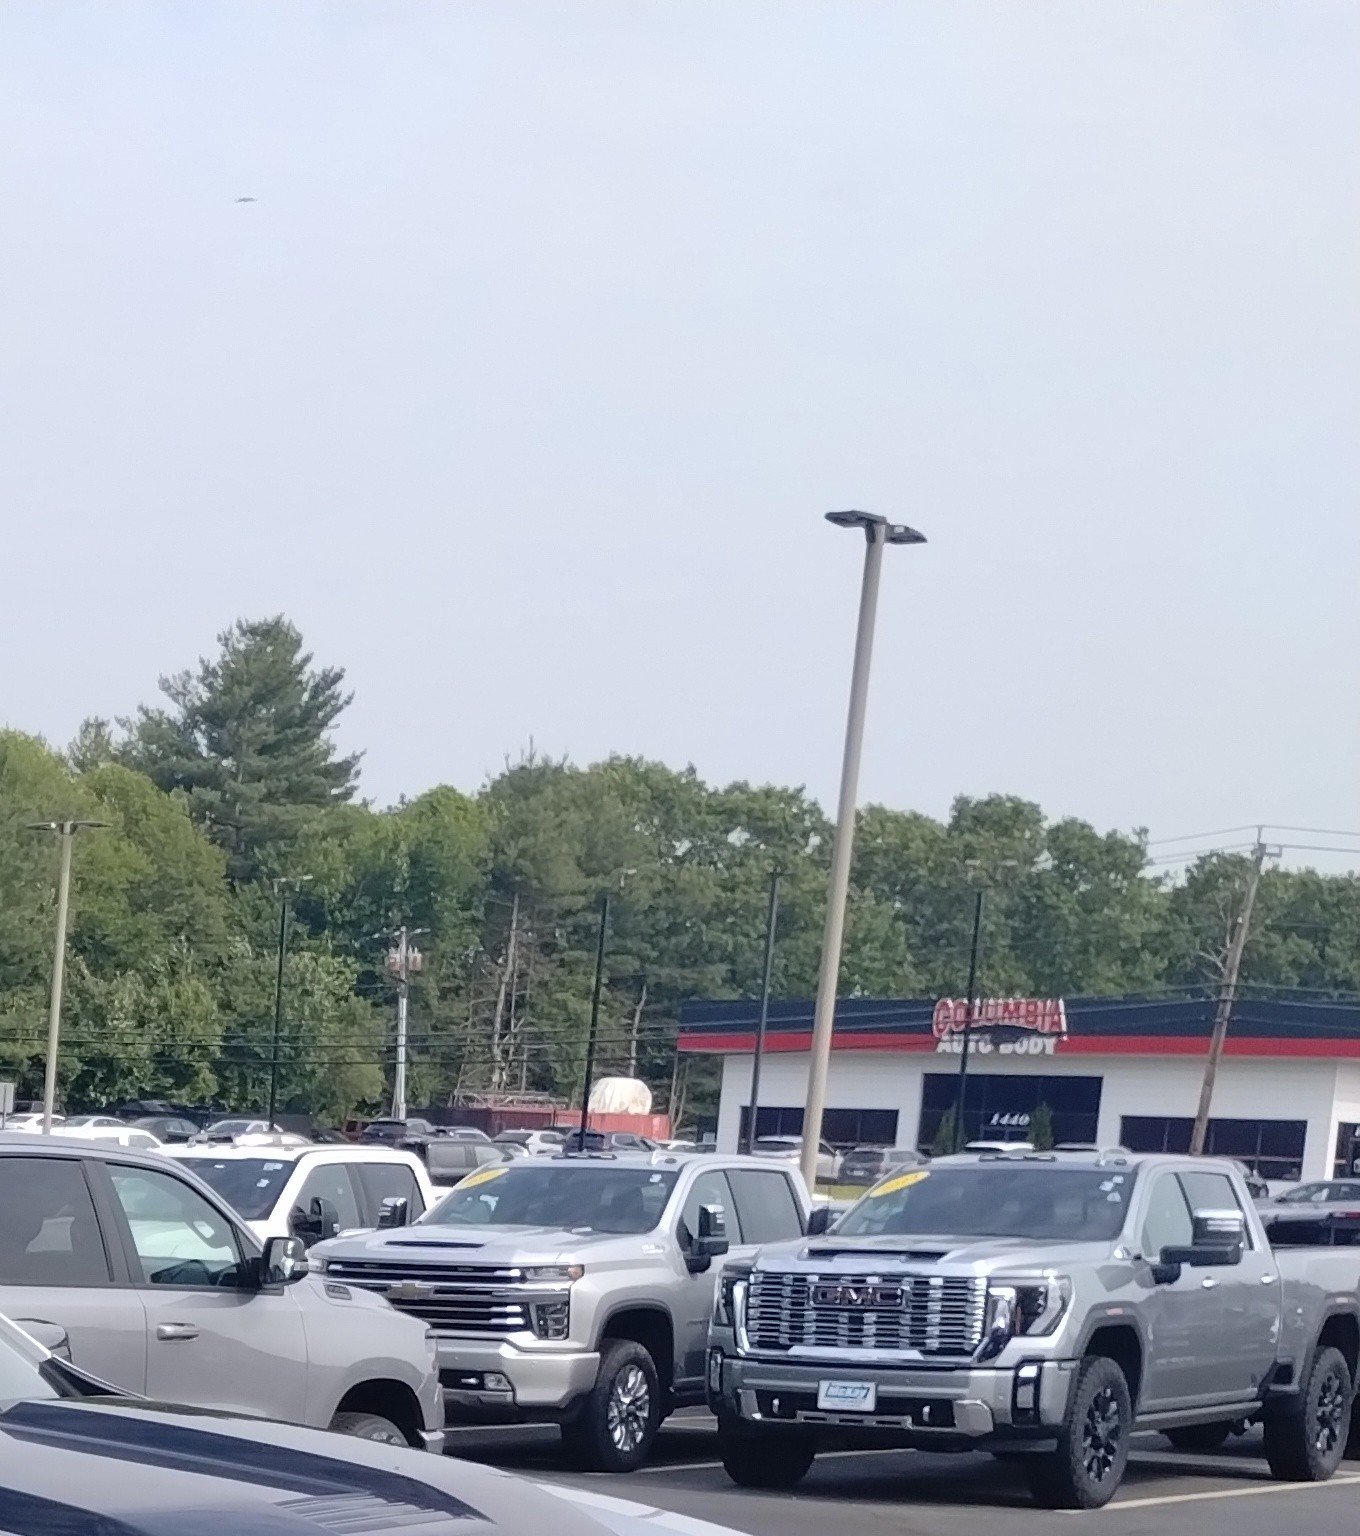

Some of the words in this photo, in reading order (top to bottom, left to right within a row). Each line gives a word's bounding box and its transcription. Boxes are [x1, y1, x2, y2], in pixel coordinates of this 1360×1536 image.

[933, 997, 1067, 1037] COLUMBIA
[937, 1034, 992, 1053] AUTO
[990, 1112, 1030, 1126] 1440
[811, 1286, 902, 1307] GMC
